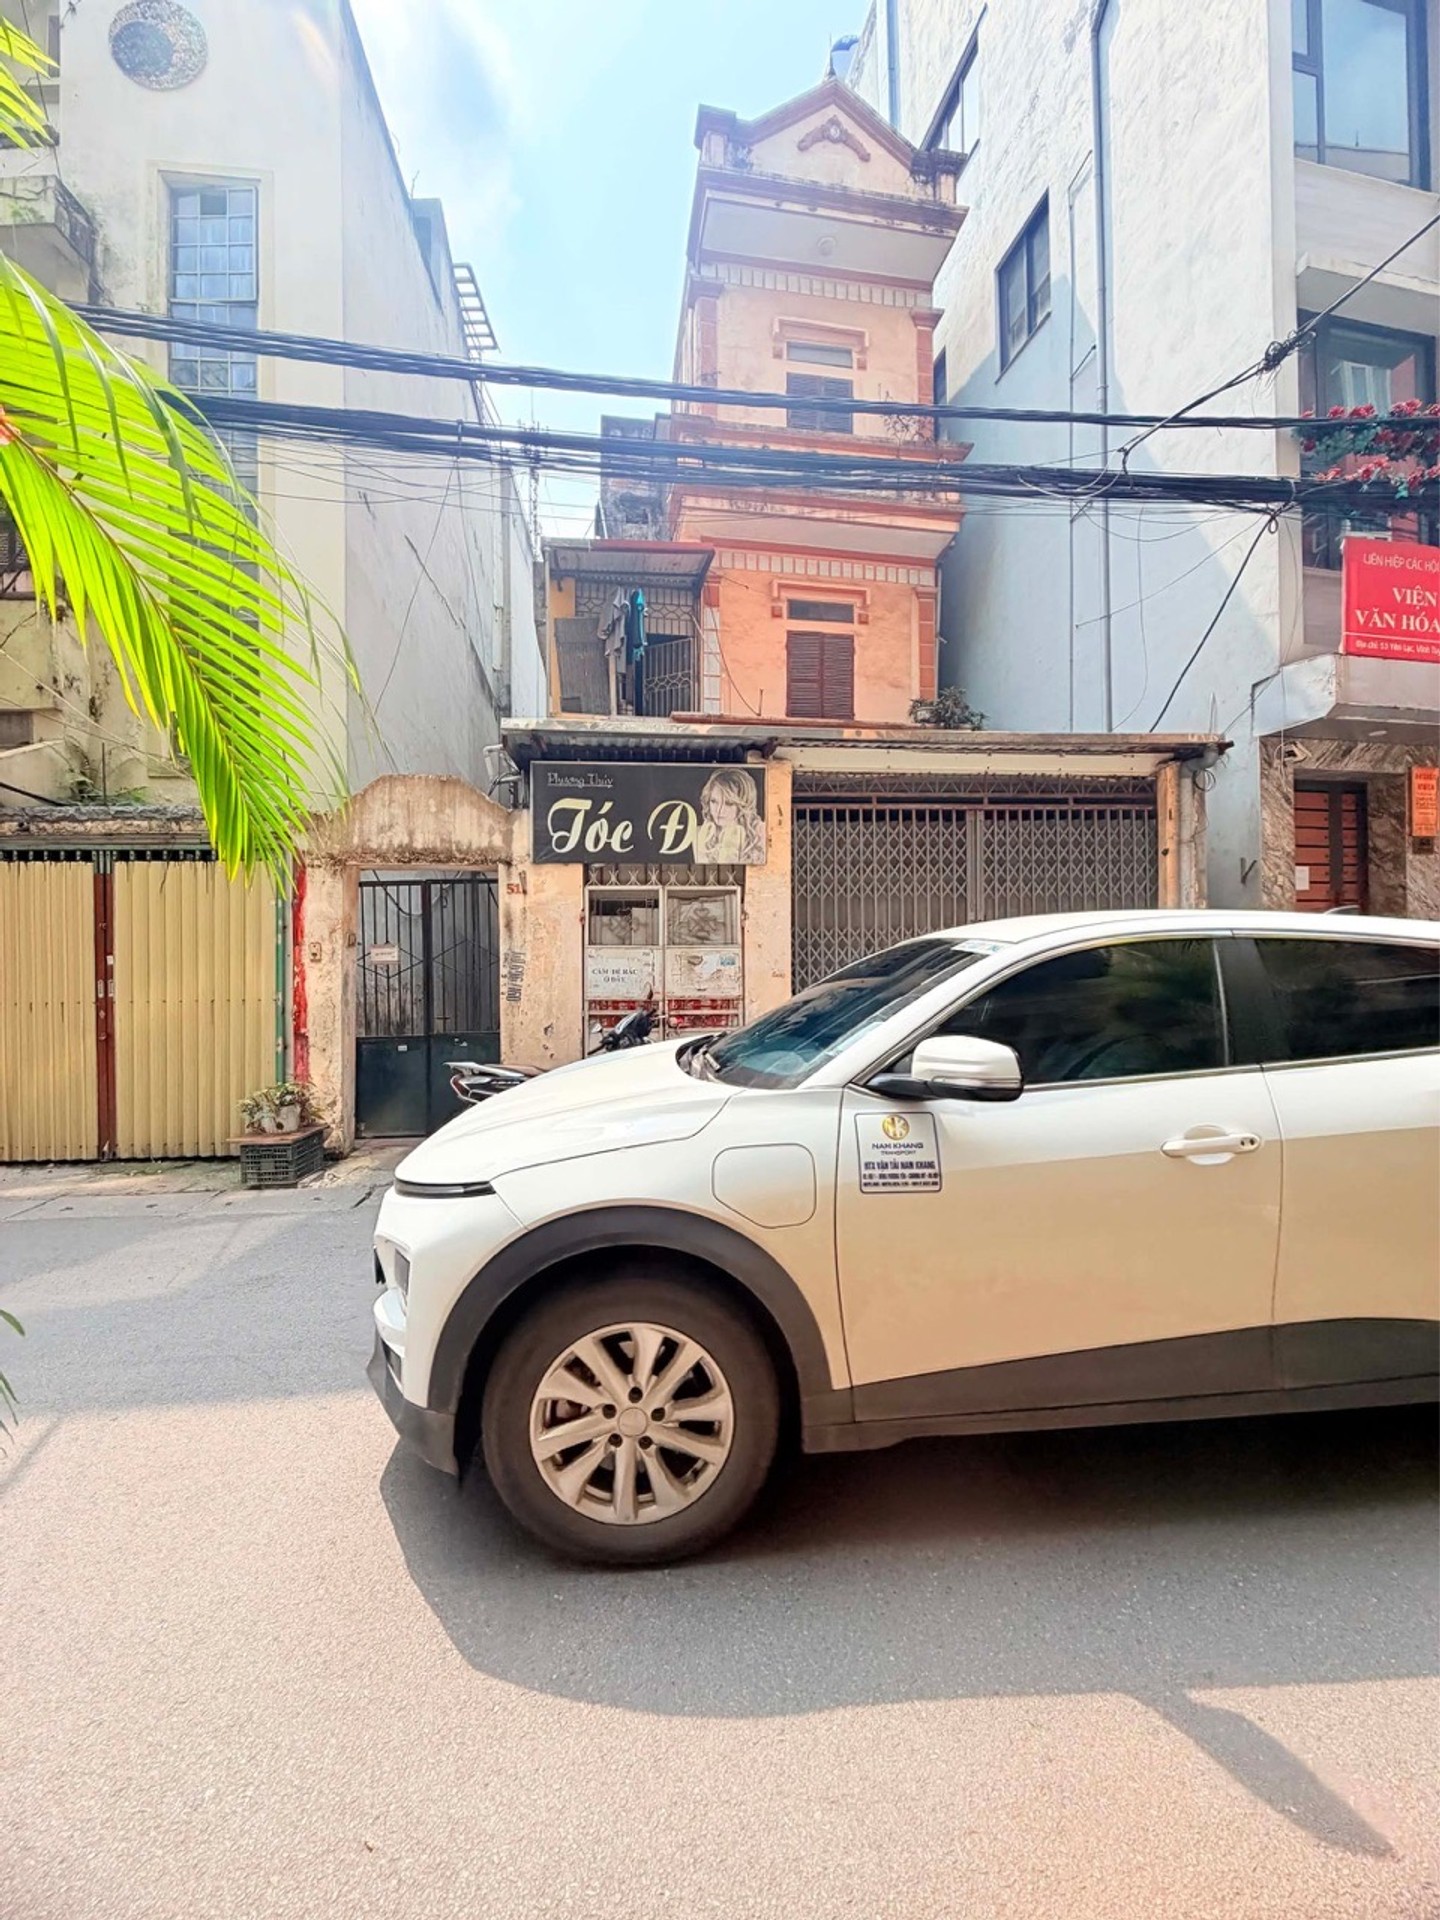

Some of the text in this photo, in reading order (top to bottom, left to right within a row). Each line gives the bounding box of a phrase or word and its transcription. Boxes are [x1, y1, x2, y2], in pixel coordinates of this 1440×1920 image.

[1363, 553, 1383, 567] LIÊN
[1405, 557, 1423, 571] CÁC
[1392, 584, 1438, 610] VIỆN
[1355, 607, 1440, 633] VĂN HÓA
[547, 797, 634, 854] Tóc
